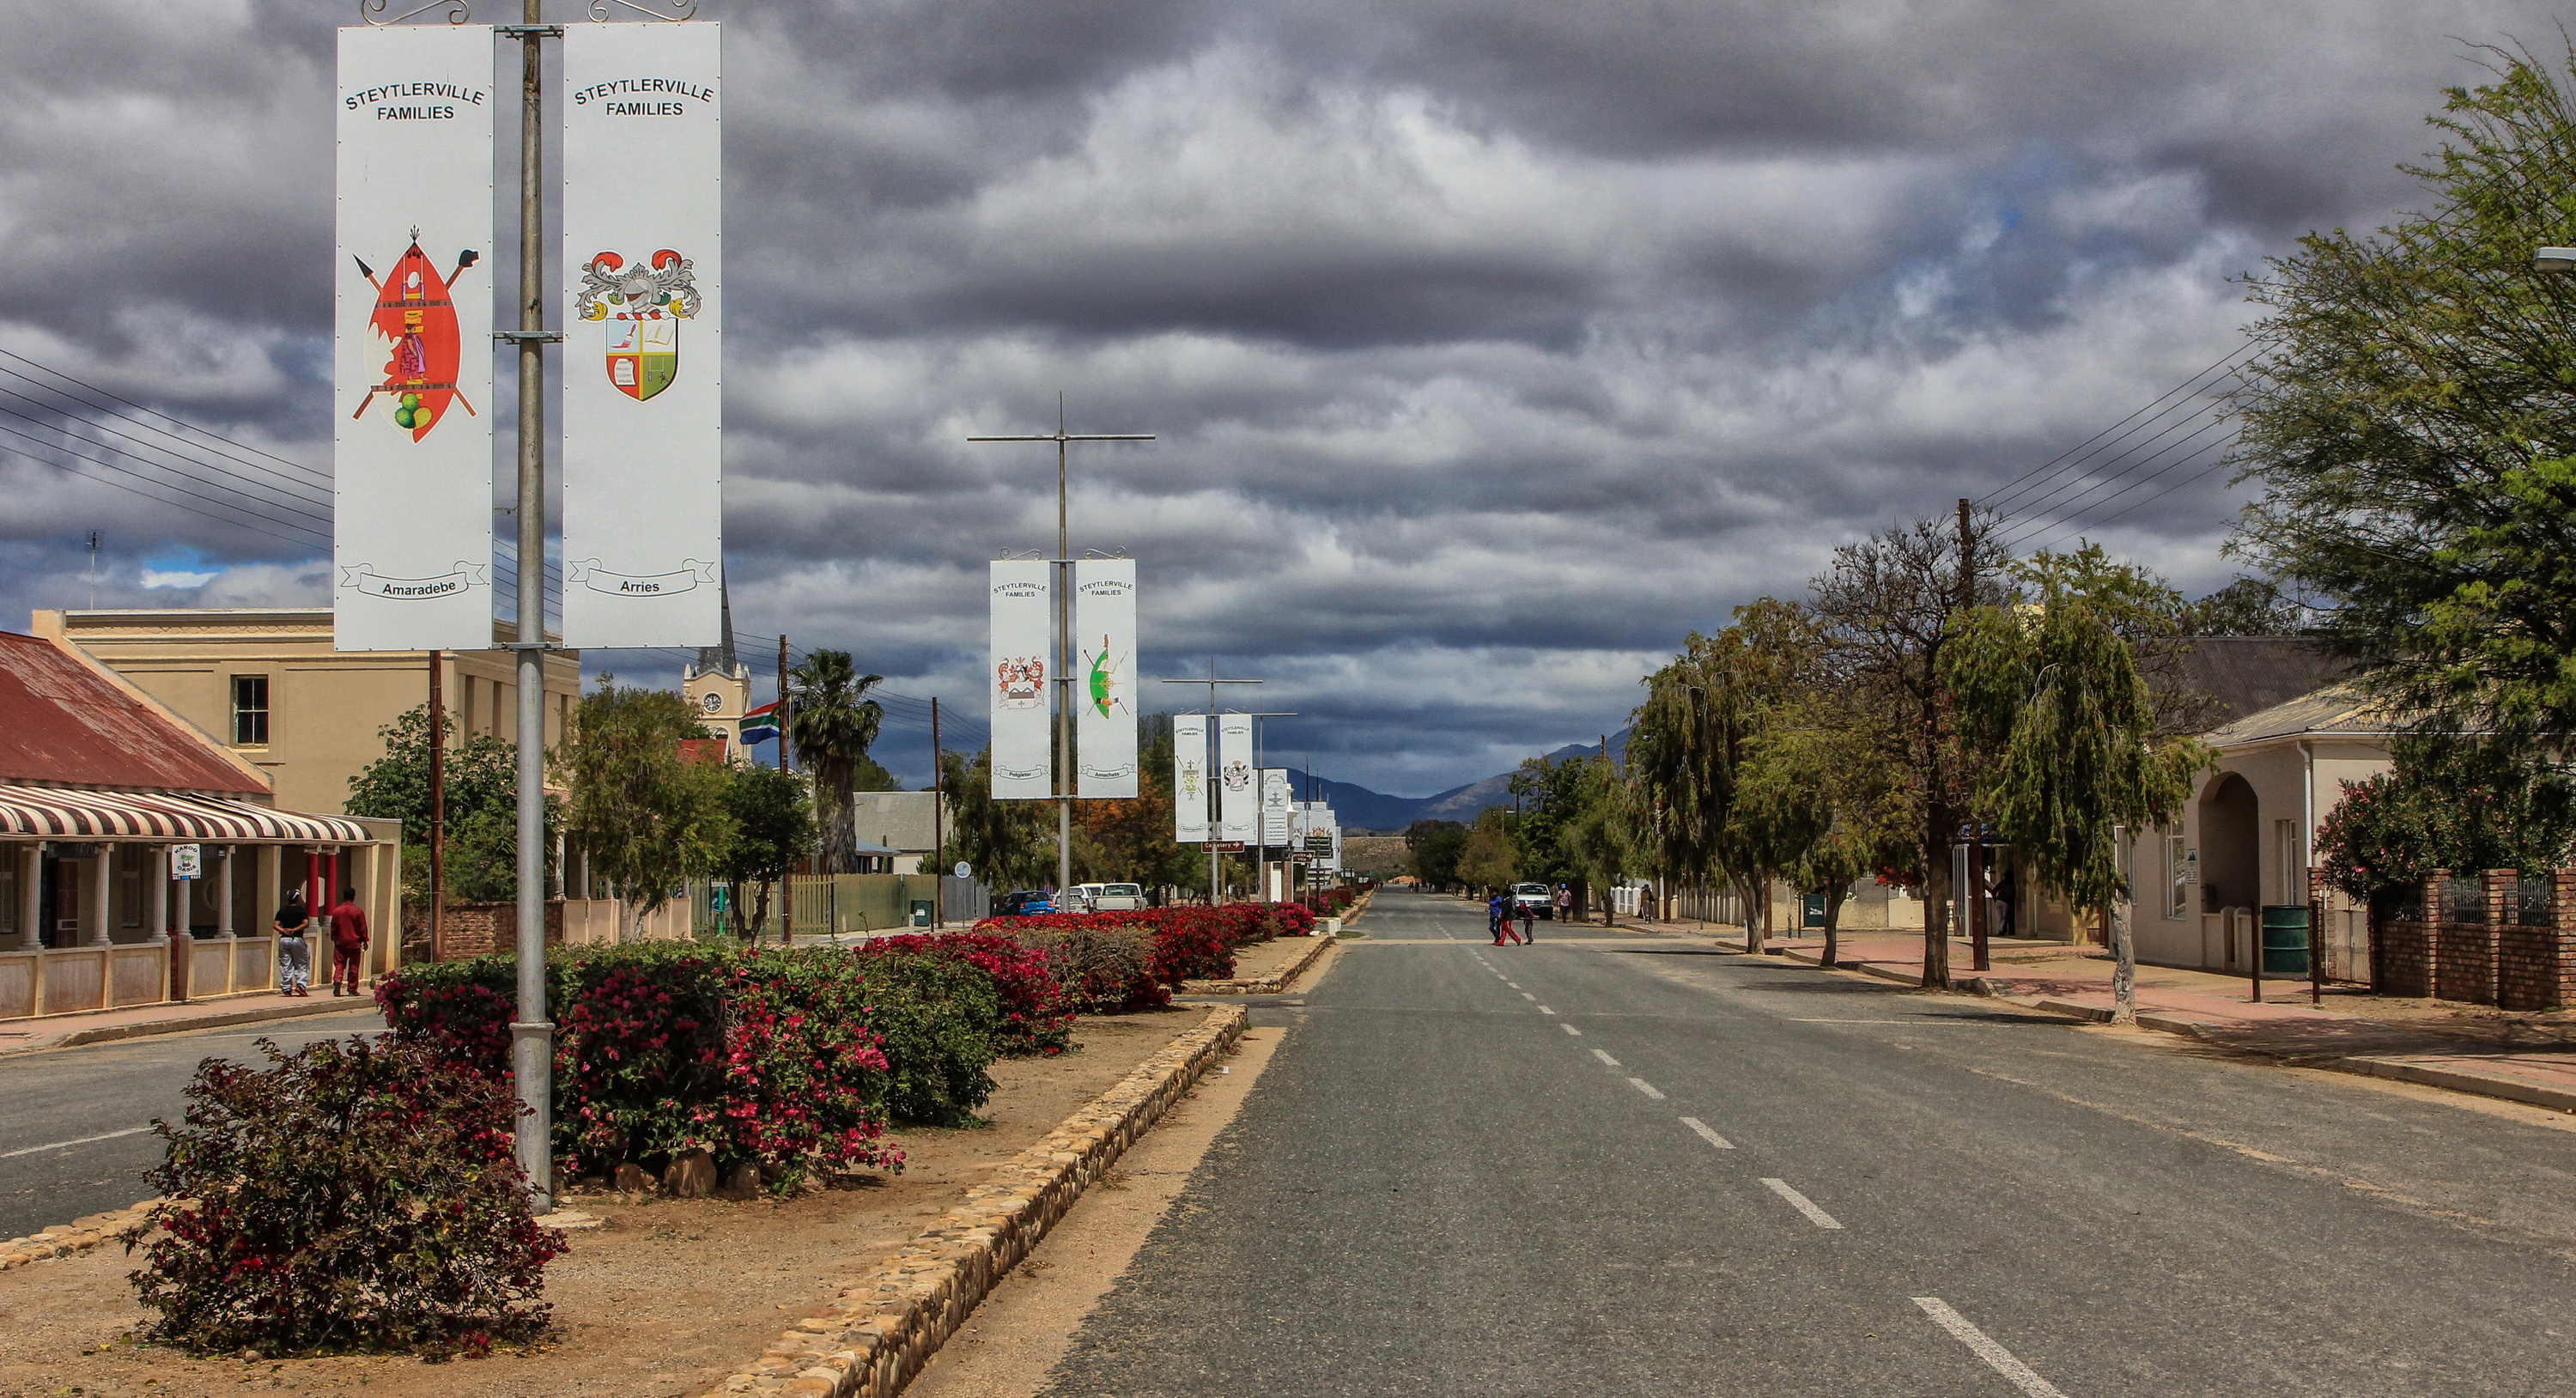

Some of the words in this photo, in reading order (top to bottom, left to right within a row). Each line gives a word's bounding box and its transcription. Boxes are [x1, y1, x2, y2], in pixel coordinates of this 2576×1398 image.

[345, 82, 485, 112] STEYTLERVILLE
[574, 78, 714, 106] STEYTLERVILLE
[378, 106, 454, 120] FAMILIES
[606, 102, 683, 117] FAMILIES
[382, 580, 457, 596] Amaradebe
[620, 579, 659, 593] Arries
[993, 582, 1047, 593] STEYTLERVILLE
[1079, 580, 1133, 593] STEYTLERVILLE
